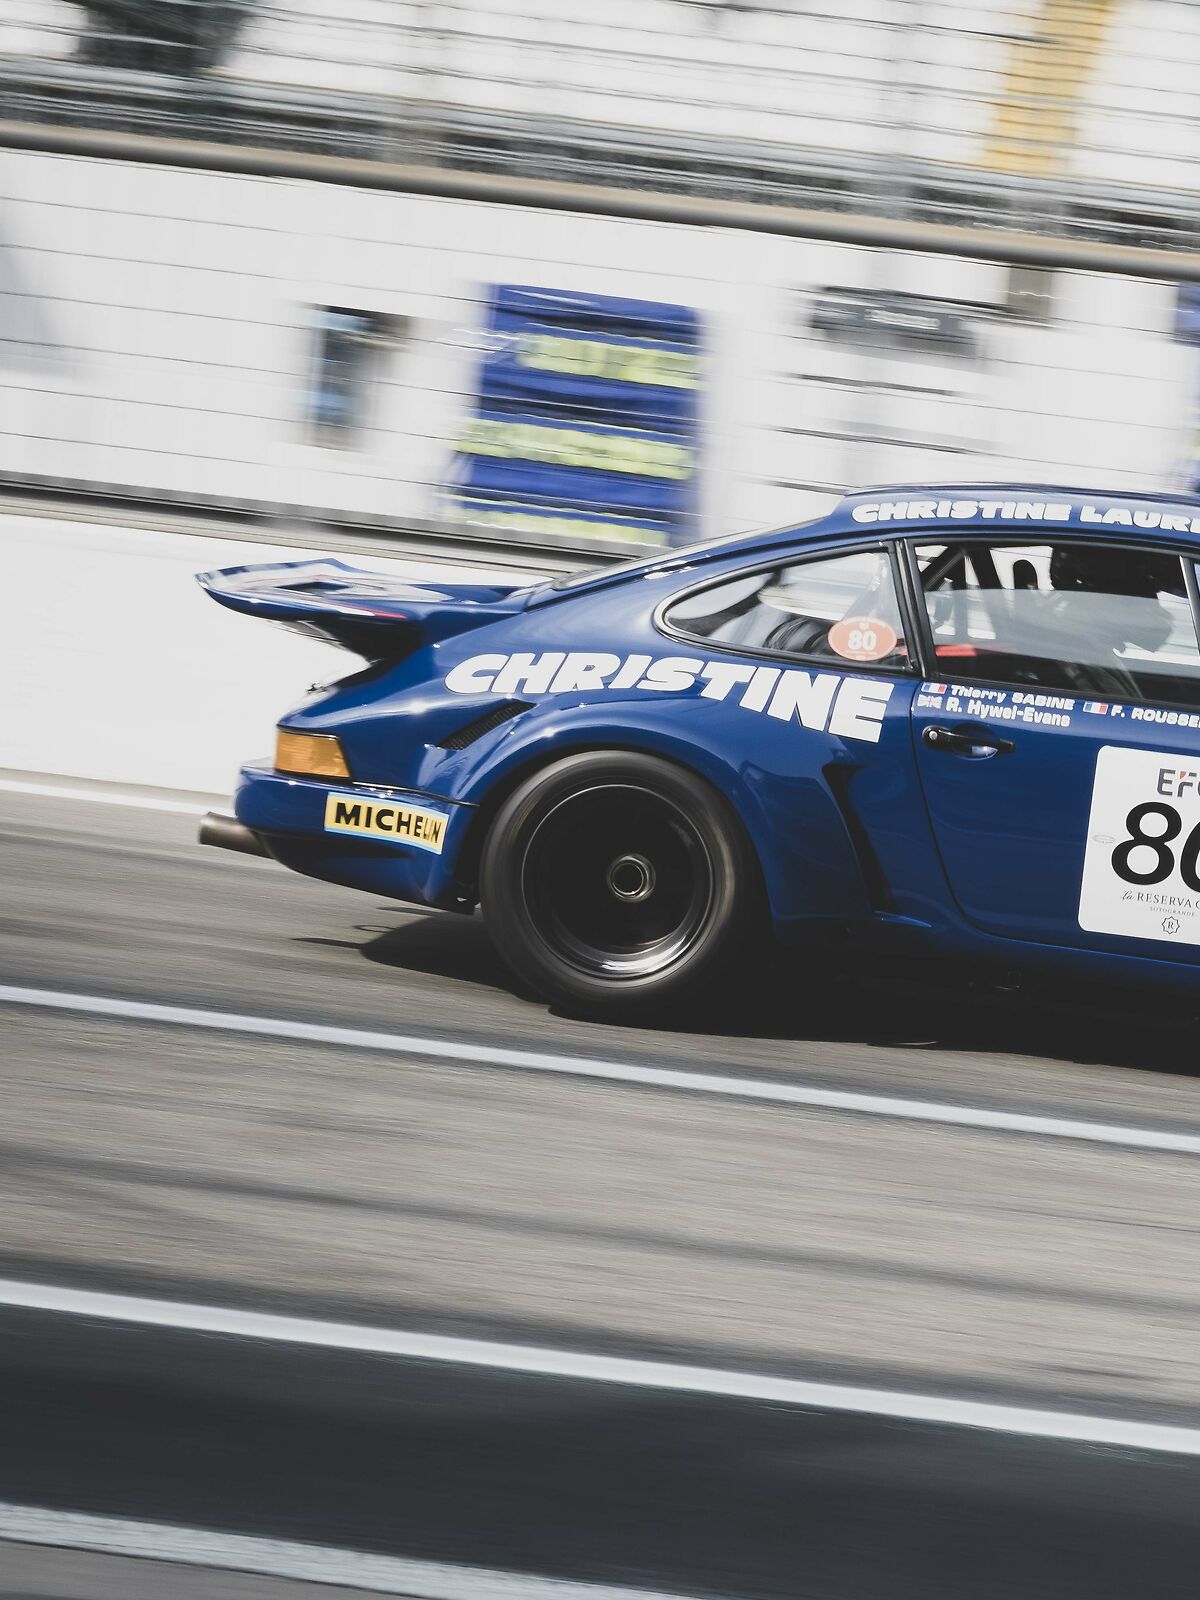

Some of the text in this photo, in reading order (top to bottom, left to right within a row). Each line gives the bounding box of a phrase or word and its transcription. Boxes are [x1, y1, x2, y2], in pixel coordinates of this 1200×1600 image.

[852, 501, 1072, 522] CHRISTINE
[848, 630, 877, 651] 80
[444, 652, 895, 743] CHRISTINE
[950, 685, 1075, 711] Thierry SABINE
[945, 697, 1070, 728] R. Hywel-Evans
[1111, 704, 1125, 718] F.
[335, 802, 441, 843] MICHELIN
[1137, 892, 1192, 908] RESERVA
